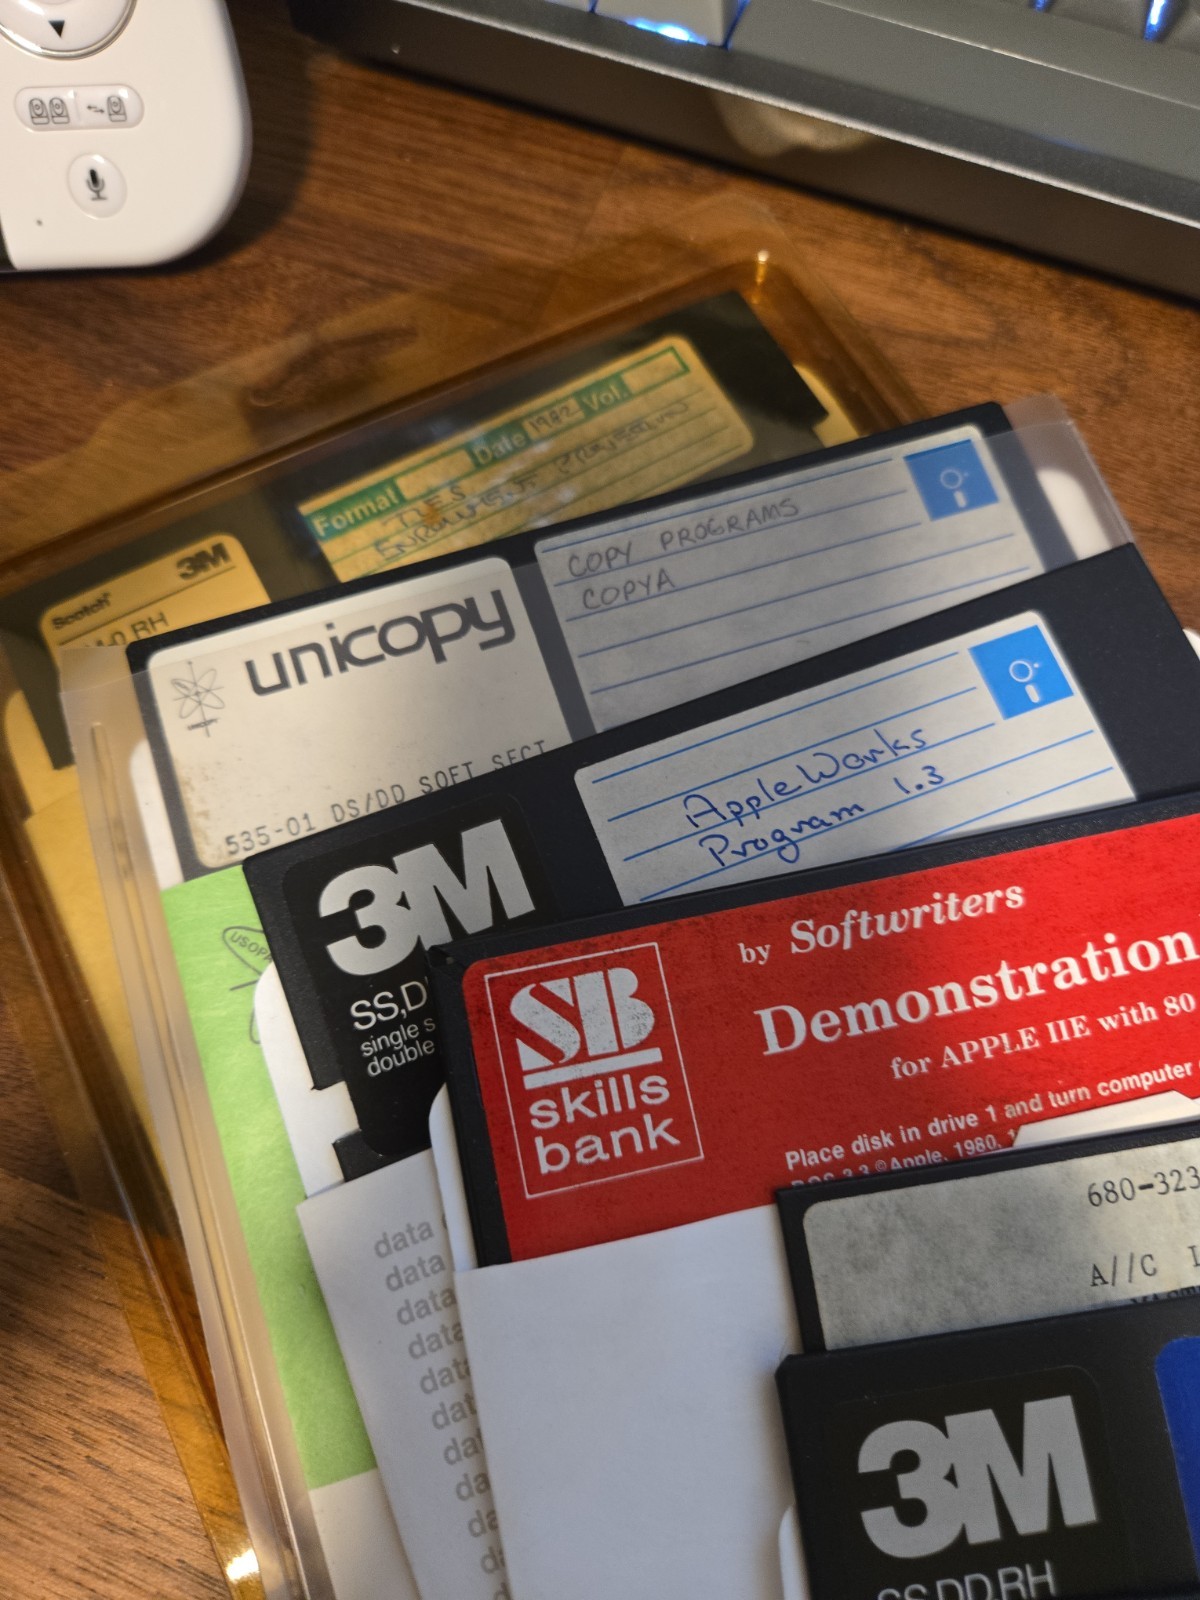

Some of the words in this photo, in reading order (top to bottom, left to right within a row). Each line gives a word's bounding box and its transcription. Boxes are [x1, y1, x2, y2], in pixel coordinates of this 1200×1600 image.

[582, 384, 629, 411] Vol.
[312, 487, 399, 537] Format
[473, 433, 527, 465] Date
[176, 543, 231, 580] 3M
[567, 541, 634, 578] COPY
[659, 497, 801, 552] PROGRAMS
[582, 567, 676, 610] COPYA
[245, 589, 516, 697] unicopy
[224, 812, 315, 856] 535-01
[331, 783, 405, 822] DS/DD
[418, 761, 474, 795] SOFT
[699, 802, 865, 867] Program
[893, 765, 945, 795] 1.3
[319, 818, 536, 976] 3M
[738, 940, 771, 966] by
[790, 884, 1025, 954] Softwriters
[350, 976, 428, 1030] SS,D
[754, 931, 1200, 1056] Demonstration
[361, 1023, 419, 1057] single
[367, 1040, 435, 1077] double
[890, 1055, 932, 1080] for
[940, 1026, 1040, 1069] APPLE
[1047, 1014, 1092, 1045] IIE
[1097, 1001, 1159, 1032] with
[1163, 992, 1196, 1017] 80
[529, 1073, 671, 1129] skills
[785, 1144, 845, 1171] Place
[851, 1129, 895, 1155] disk
[899, 1125, 921, 1144] in
[928, 1112, 979, 1137] drive
[985, 1104, 998, 1122] 1
[1005, 1093, 1044, 1119] and
[1048, 1083, 1092, 1106] turn
[1097, 1061, 1193, 1098] computer
[534, 1113, 682, 1175] bank
[374, 1220, 435, 1259] data
[386, 1254, 446, 1292] data
[397, 1287, 457, 1326] data
[858, 1394, 1098, 1559] 3M
